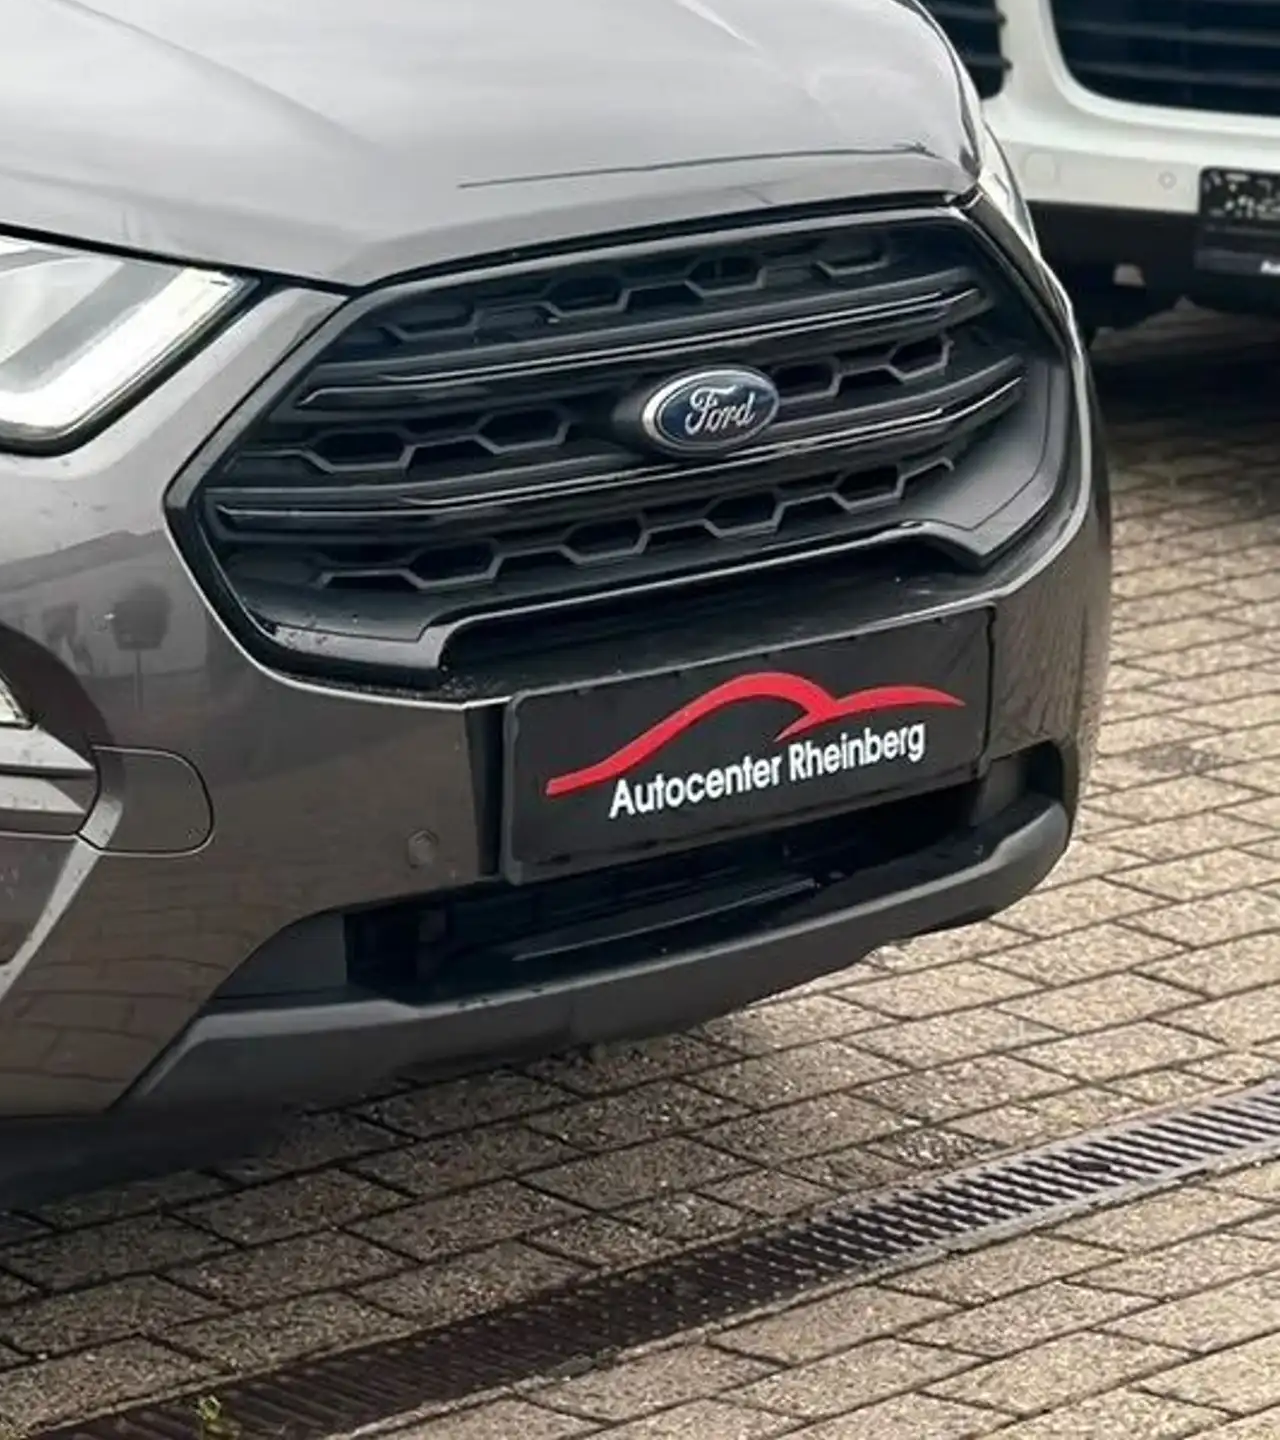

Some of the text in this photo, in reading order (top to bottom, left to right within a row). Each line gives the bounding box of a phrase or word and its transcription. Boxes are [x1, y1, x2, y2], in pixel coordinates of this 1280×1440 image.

[685, 385, 756, 436] Ford
[608, 721, 926, 819] Autocenter Rheinberg
